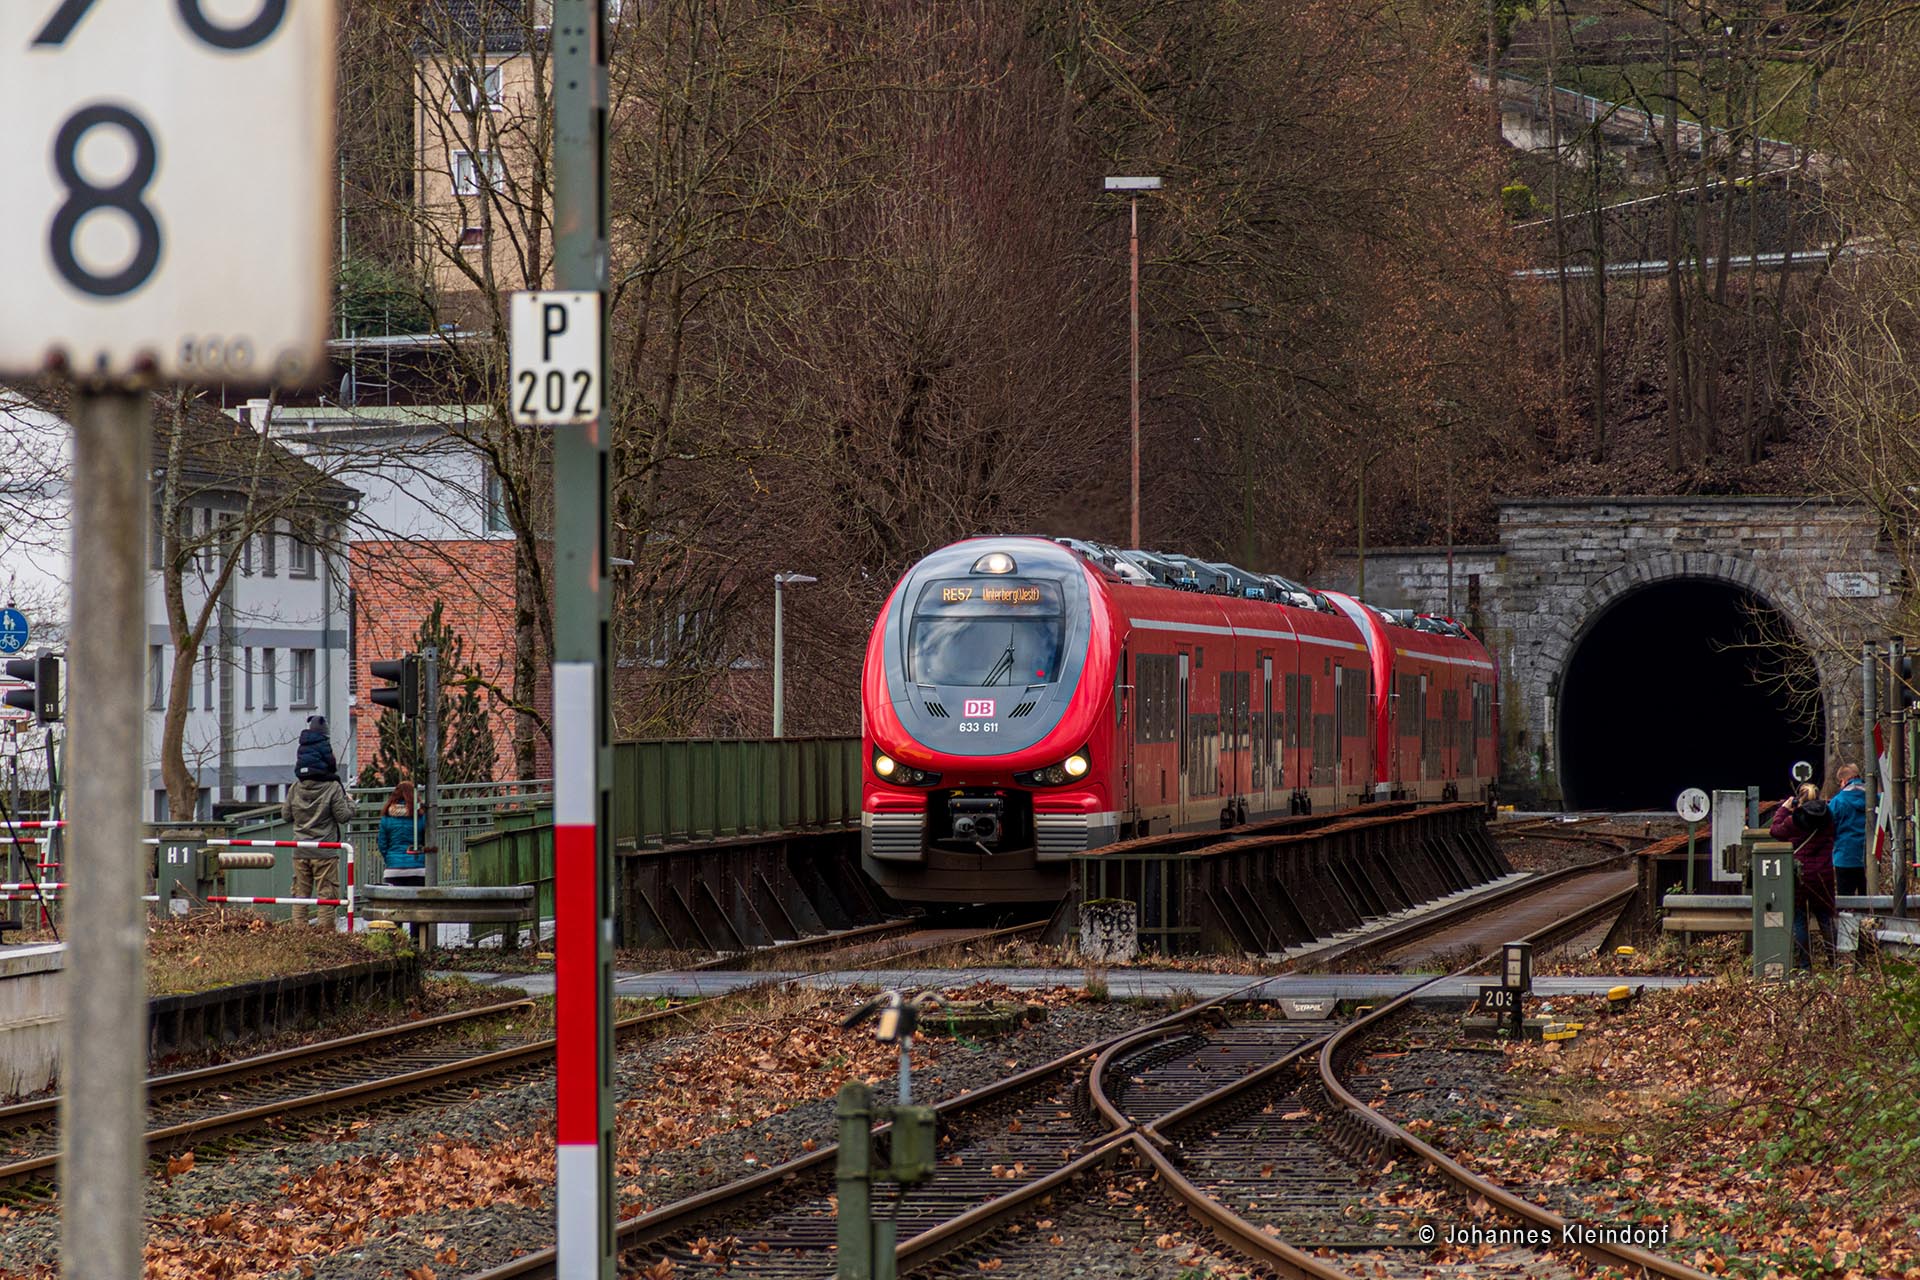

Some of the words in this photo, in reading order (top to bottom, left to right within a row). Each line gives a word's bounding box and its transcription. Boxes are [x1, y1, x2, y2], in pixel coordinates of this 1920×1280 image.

[50, 104, 160, 297] 8
[544, 303, 567, 362] P
[518, 370, 592, 414] 202
[943, 588, 973, 601] RE57
[966, 701, 992, 716] DB
[959, 722, 980, 732] 633
[983, 722, 999, 732] 611
[1762, 859, 1781, 876] F1
[1485, 990, 1513, 1007] 203
